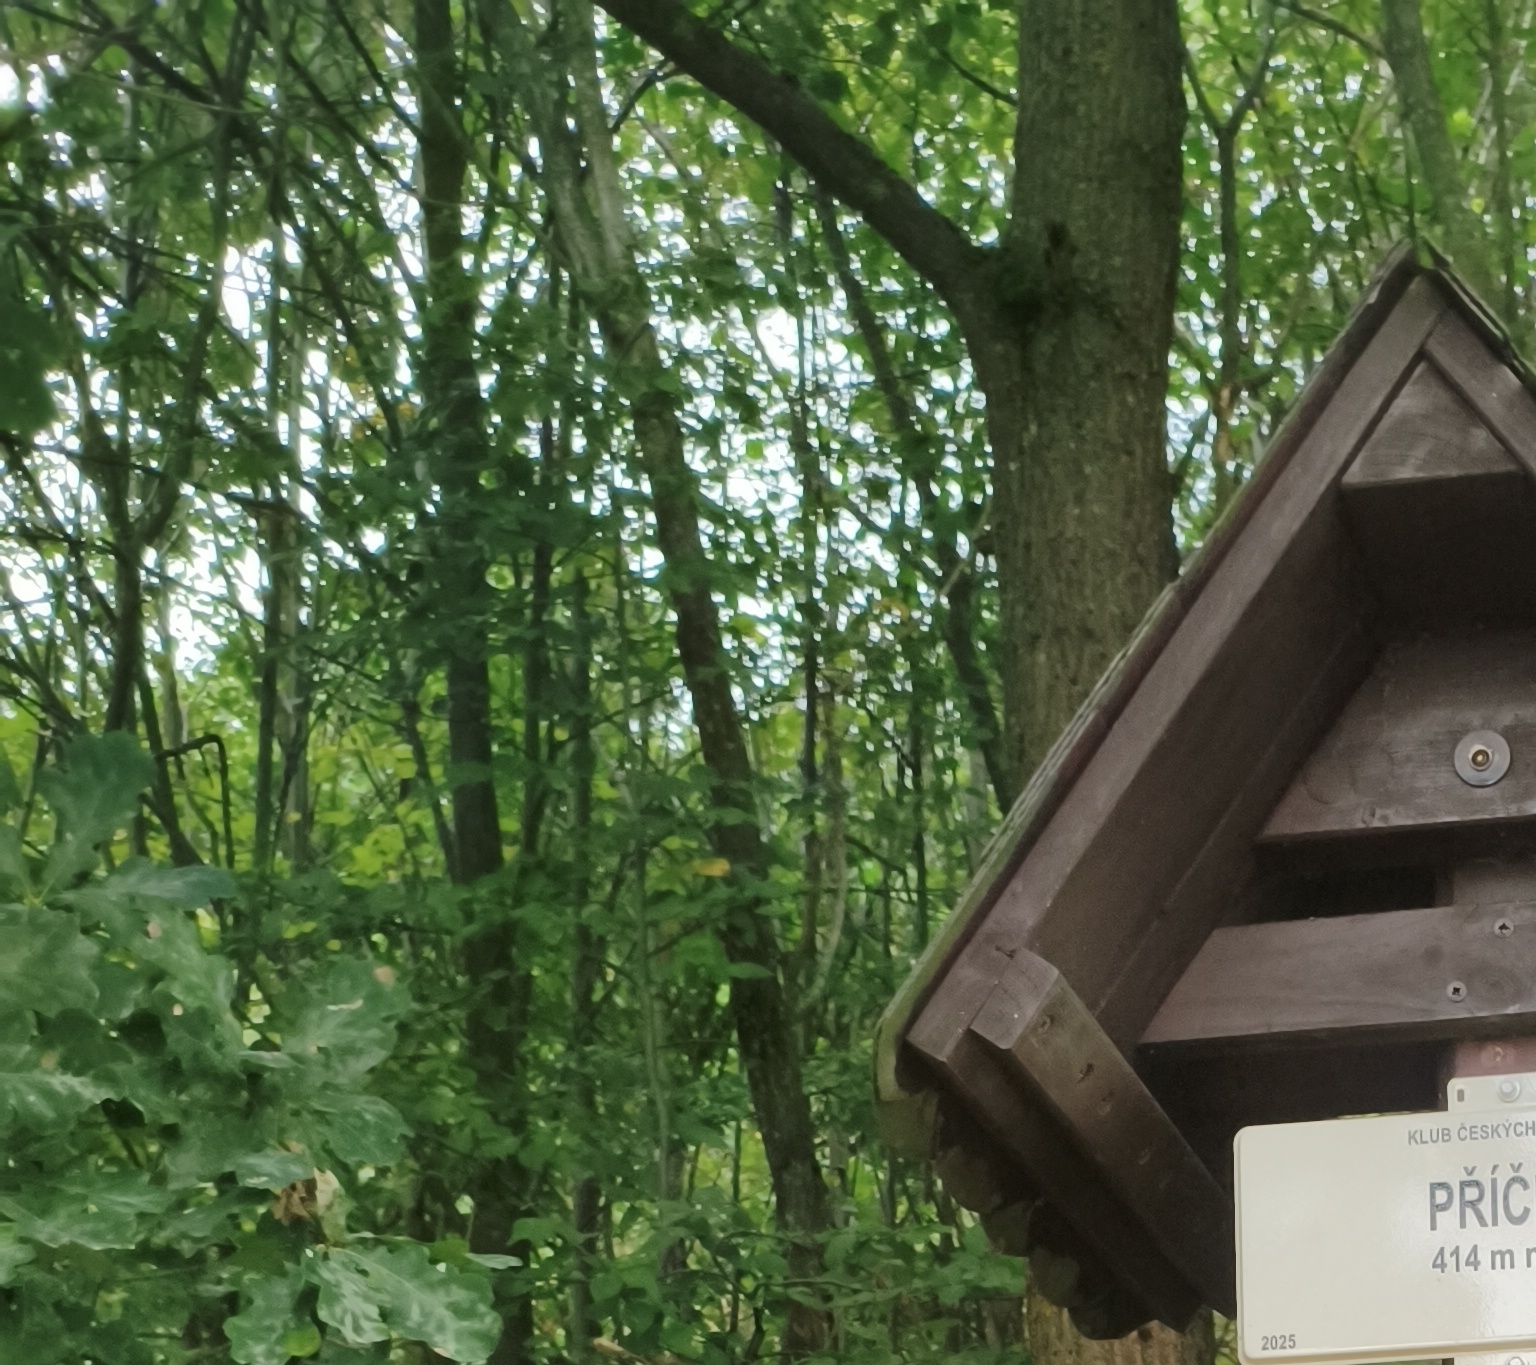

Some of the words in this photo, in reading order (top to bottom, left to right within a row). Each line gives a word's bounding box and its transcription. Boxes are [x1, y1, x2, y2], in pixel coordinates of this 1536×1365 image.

[1408, 1128, 1451, 1146] KLUB
[1432, 1244, 1480, 1274] 414
[1491, 1246, 1515, 1270] m
[1261, 1334, 1296, 1351] 2025
